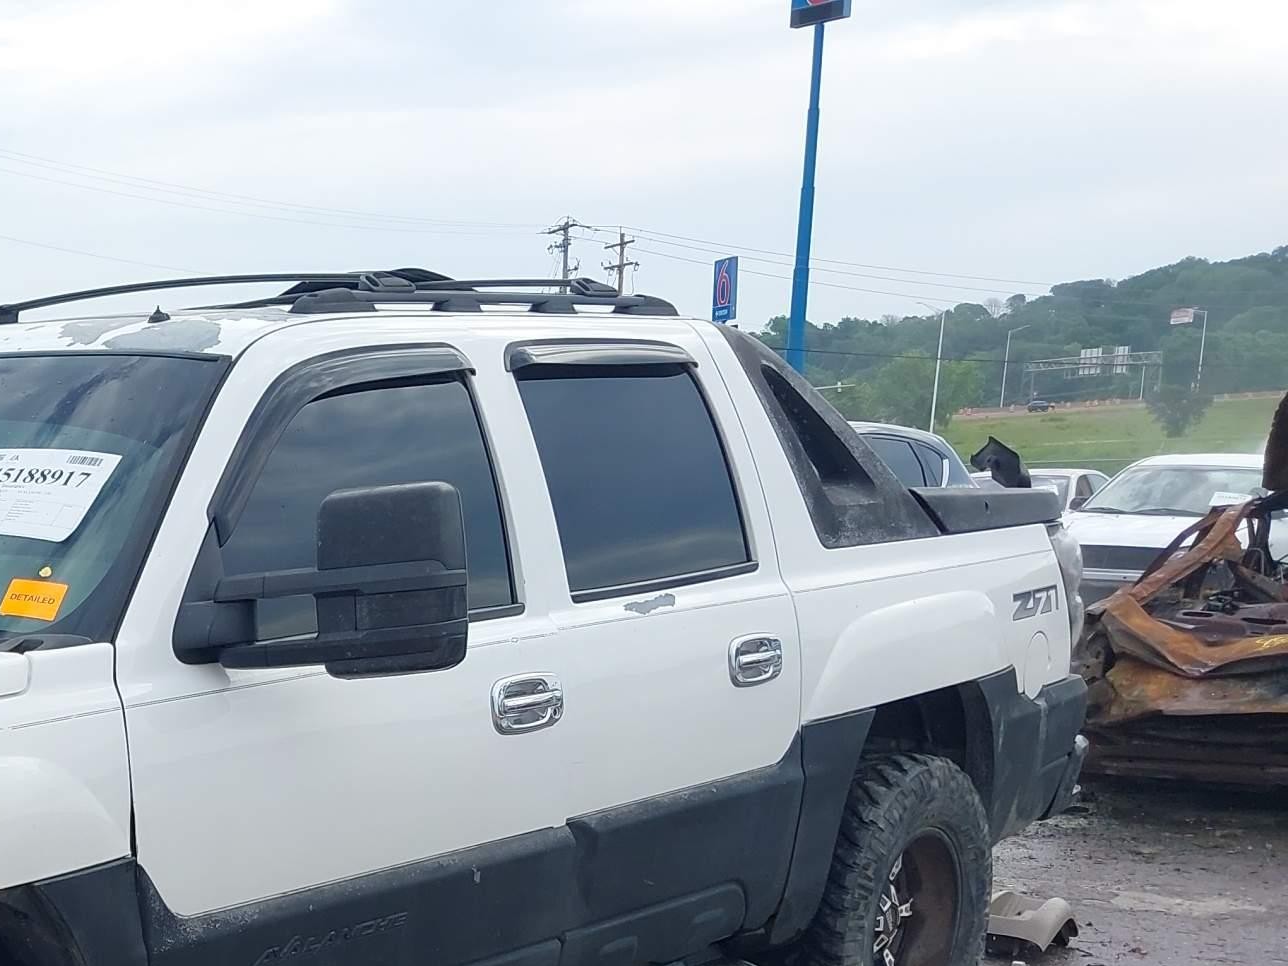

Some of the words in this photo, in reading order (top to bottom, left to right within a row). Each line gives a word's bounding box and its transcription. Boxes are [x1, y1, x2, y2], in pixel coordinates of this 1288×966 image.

[717, 260, 730, 307] 6
[9, 593, 56, 605] DETAILED
[1012, 584, 1059, 621] Z71
